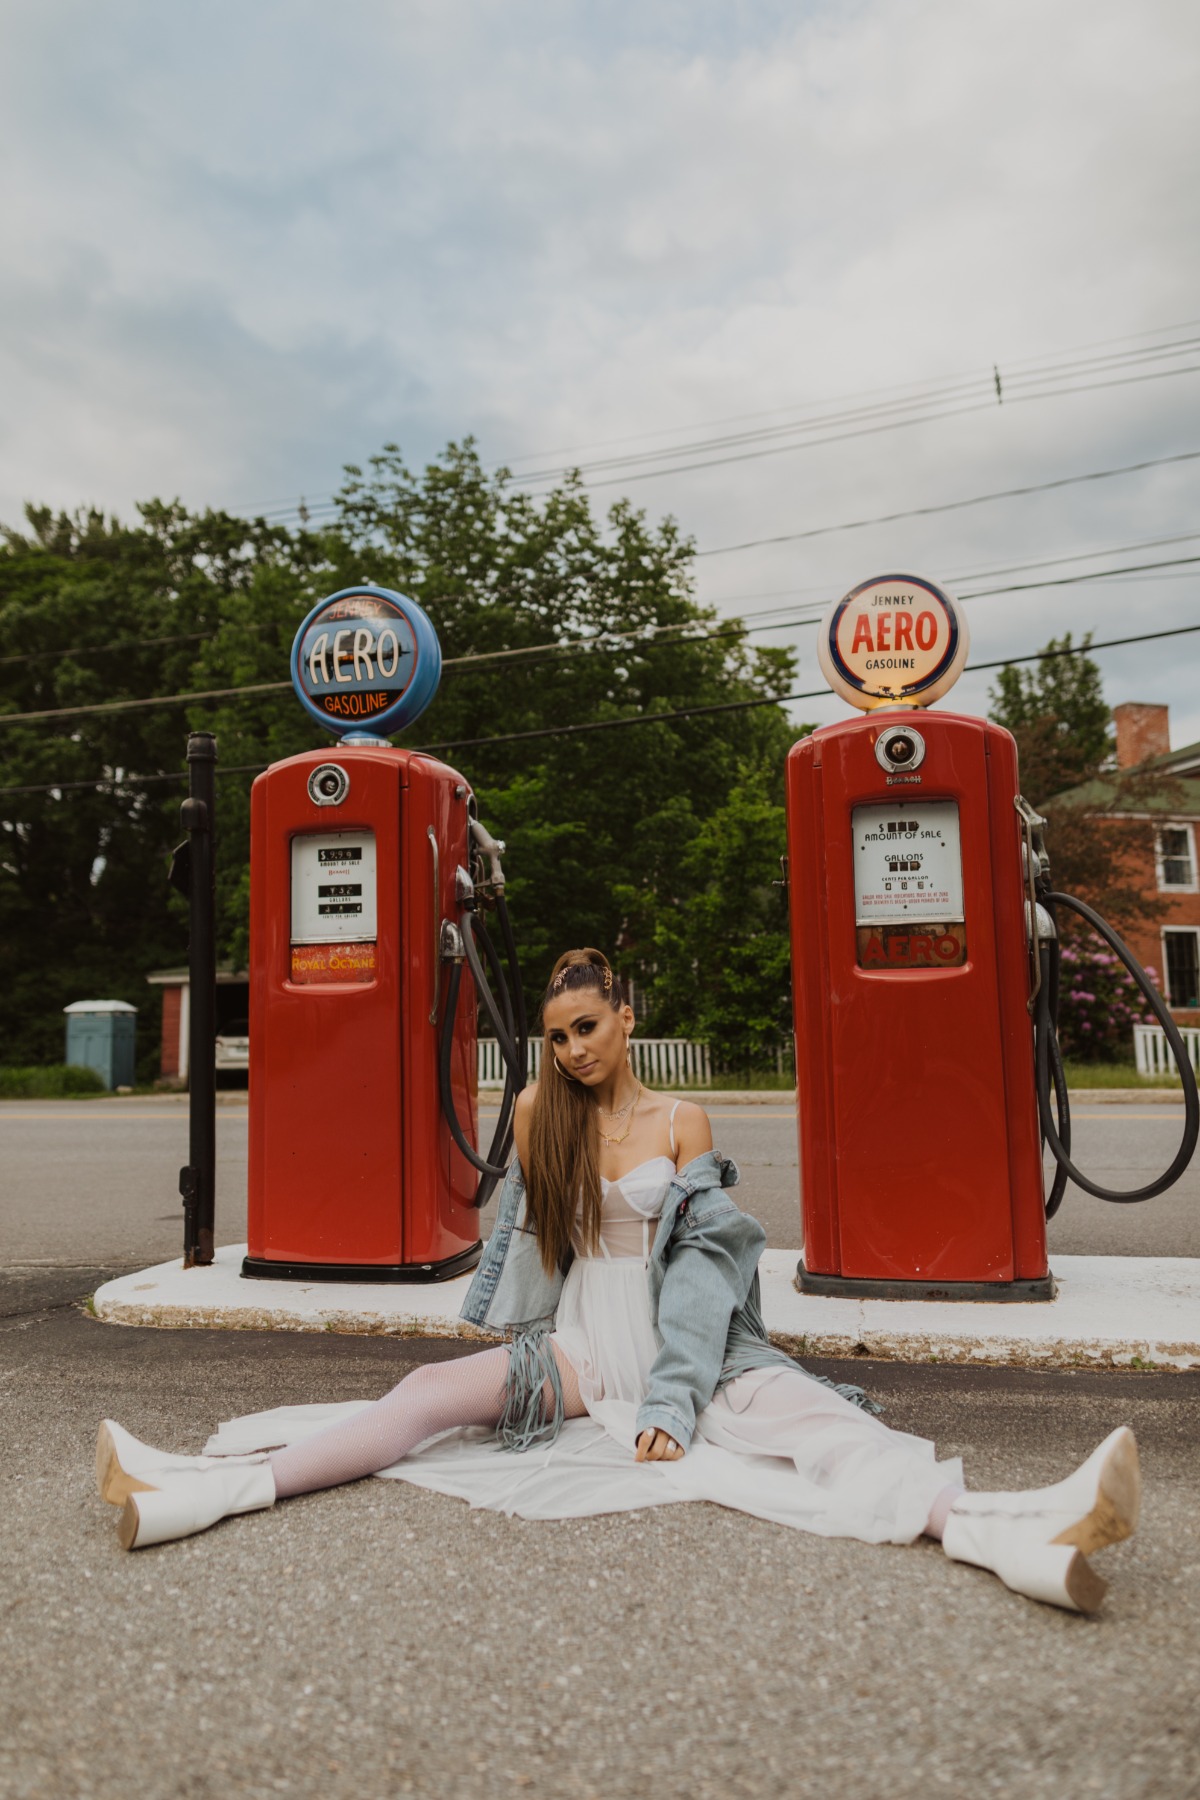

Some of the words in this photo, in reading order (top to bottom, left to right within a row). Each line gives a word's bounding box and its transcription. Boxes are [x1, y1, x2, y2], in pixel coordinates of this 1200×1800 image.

[871, 595, 914, 606] JENNEY
[329, 601, 382, 620] JENNEY
[851, 610, 938, 654] AERO
[309, 628, 400, 684] AERO
[865, 658, 916, 670] GASOLINE
[324, 692, 388, 715] GASOLINE
[864, 832, 902, 842] AMOUNT
[905, 832, 917, 840] OF
[920, 830, 942, 838] SALE
[884, 854, 924, 862] GALLONS
[862, 935, 960, 962] AERO
[292, 957, 326, 970] ROYAL
[329, 956, 375, 970] OCTANE
